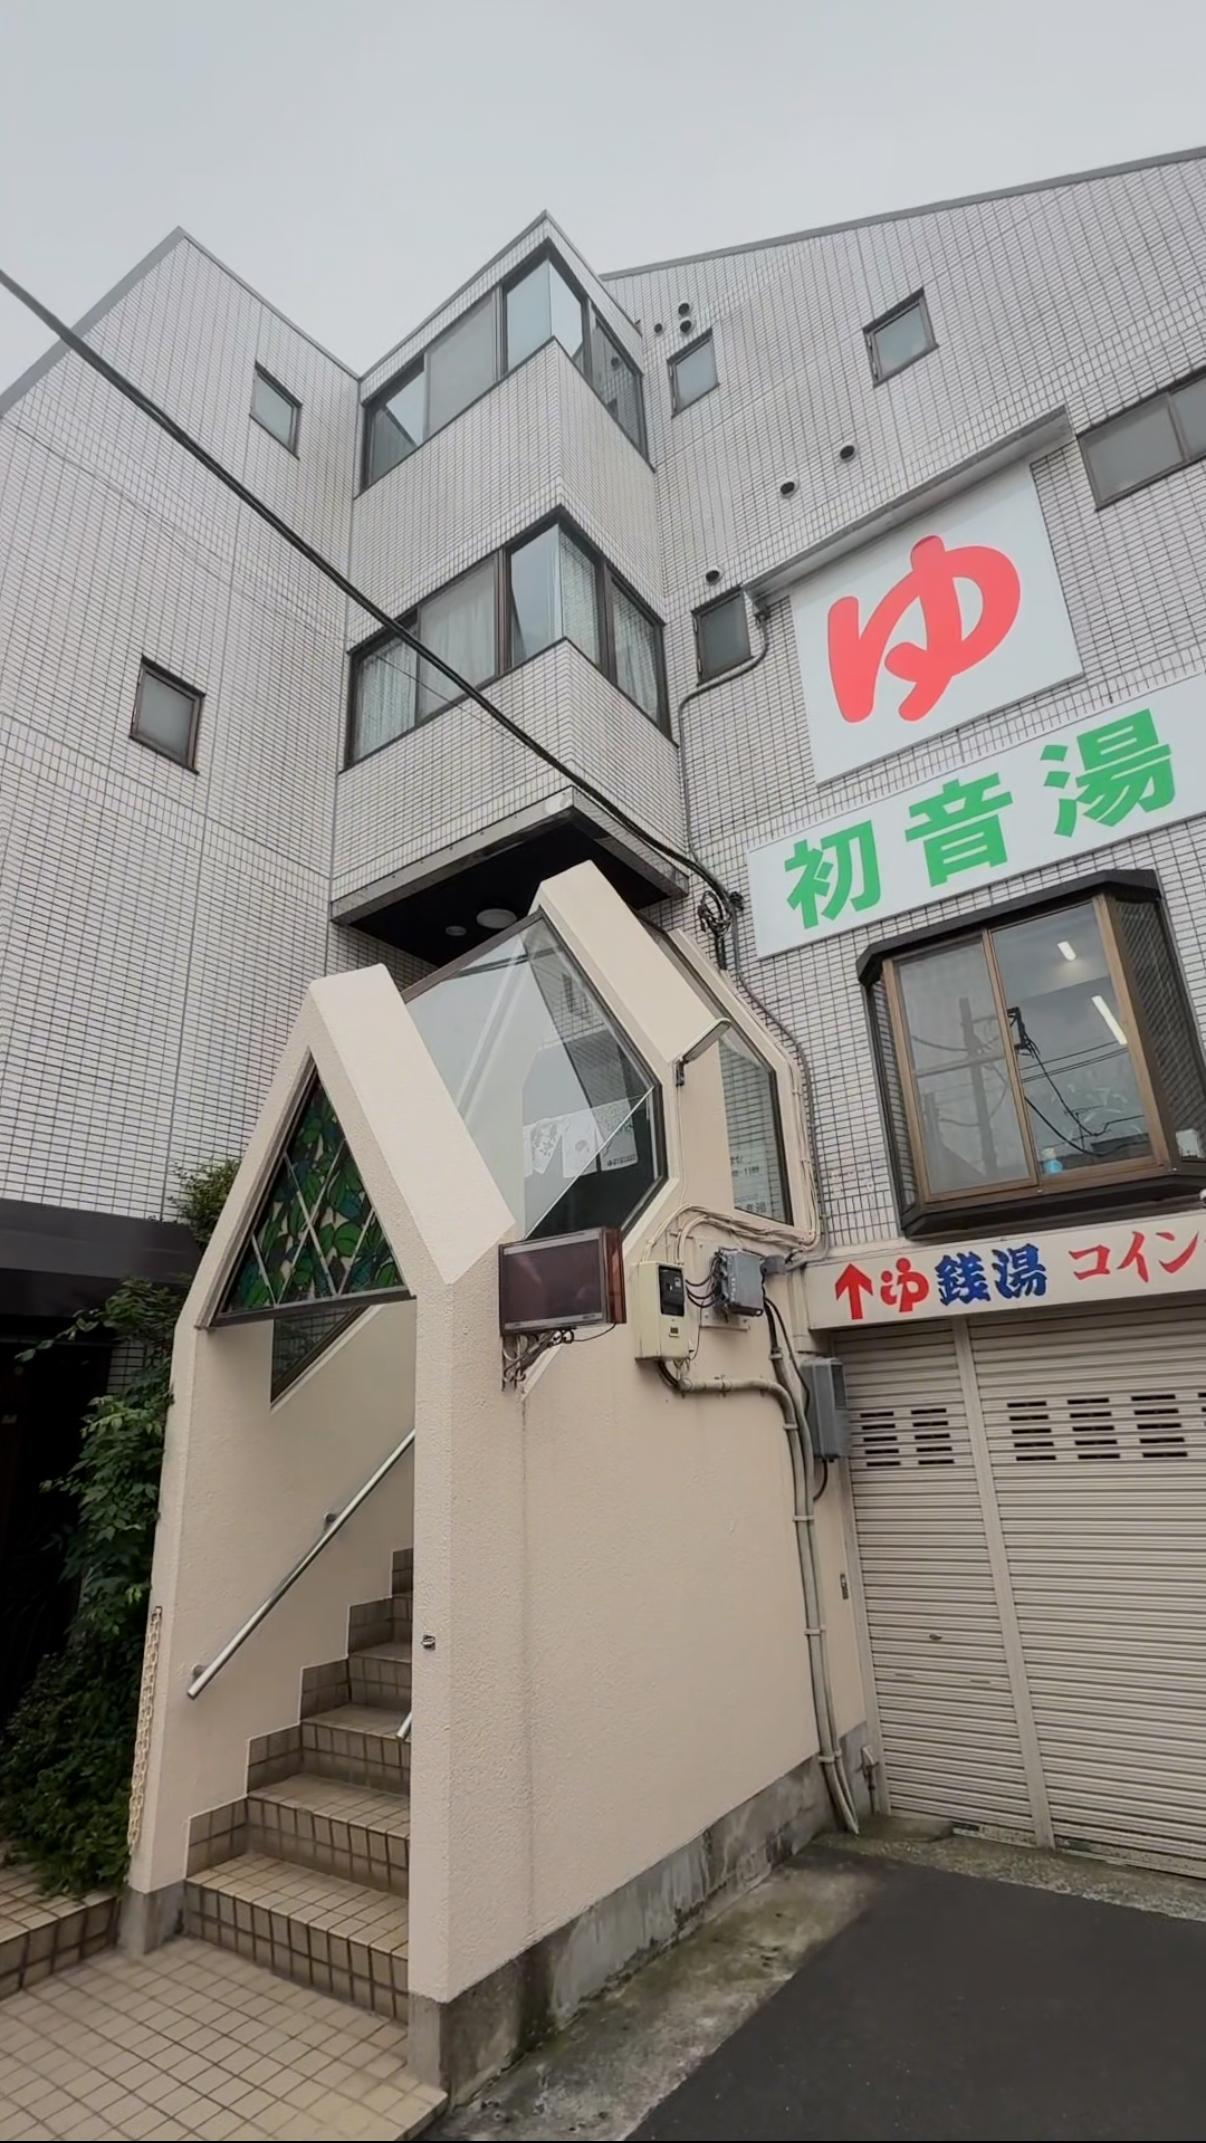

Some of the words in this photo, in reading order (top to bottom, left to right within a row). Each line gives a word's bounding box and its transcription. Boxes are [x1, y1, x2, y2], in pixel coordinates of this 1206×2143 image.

[827, 534, 1021, 724] ゆ
[784, 708, 1176, 929] 初音湯
